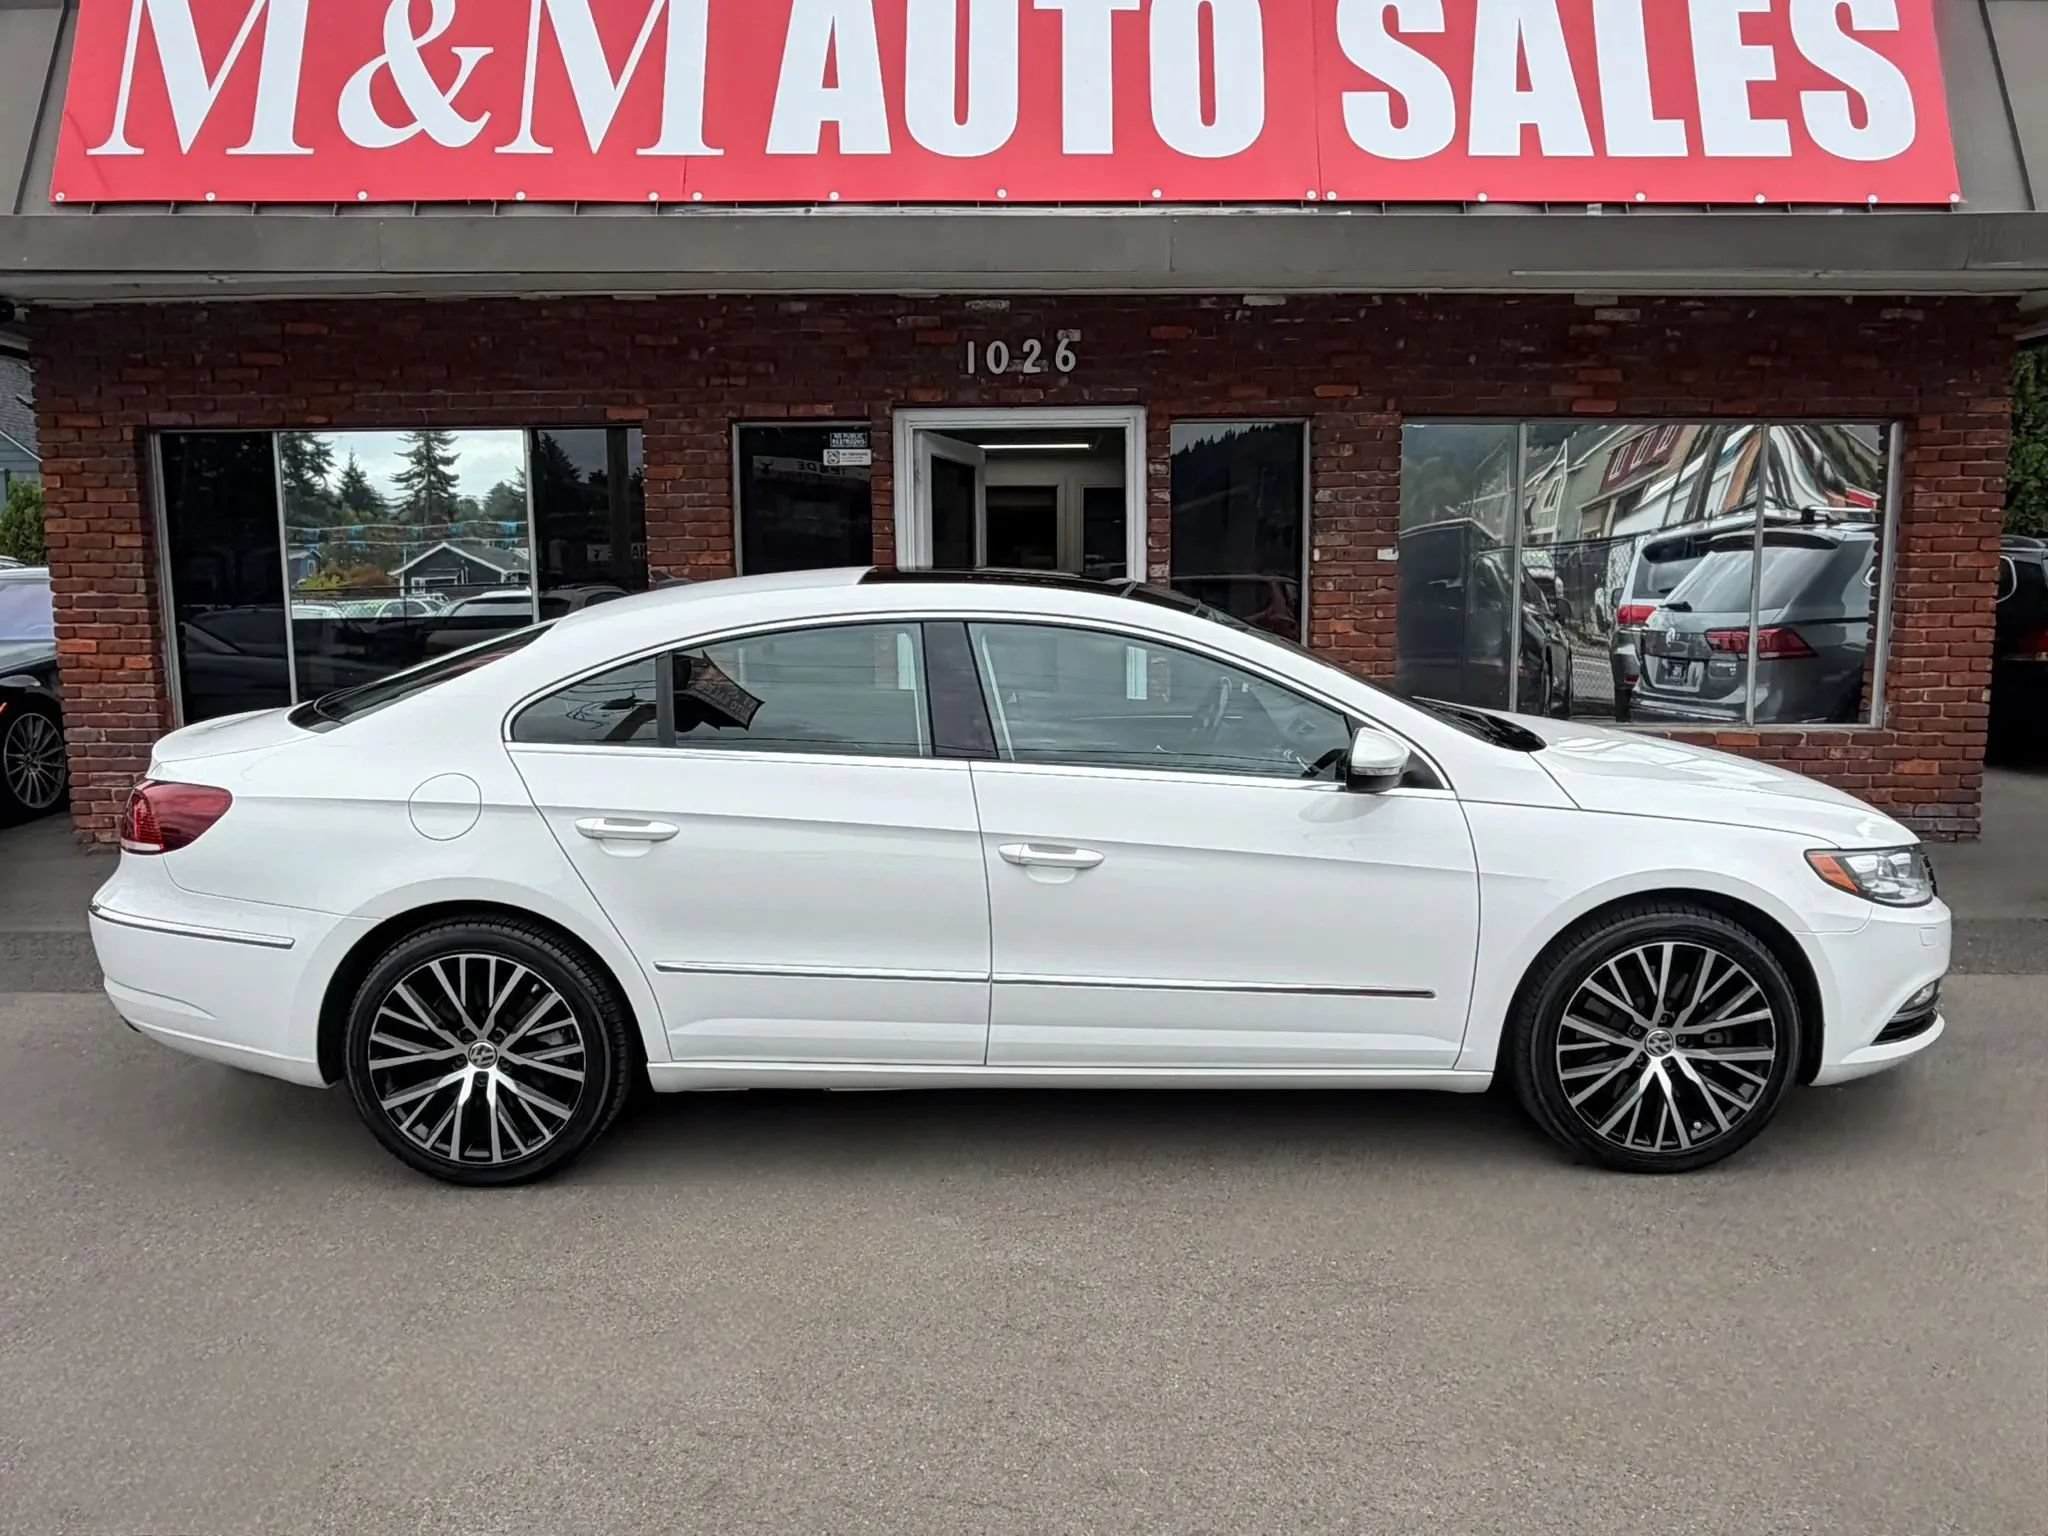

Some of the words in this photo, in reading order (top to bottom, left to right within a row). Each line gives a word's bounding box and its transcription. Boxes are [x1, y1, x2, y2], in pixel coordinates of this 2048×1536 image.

[764, 0, 1266, 158] AUTO
[1336, 0, 1917, 160] SALES
[967, 337, 1077, 375] 1026
